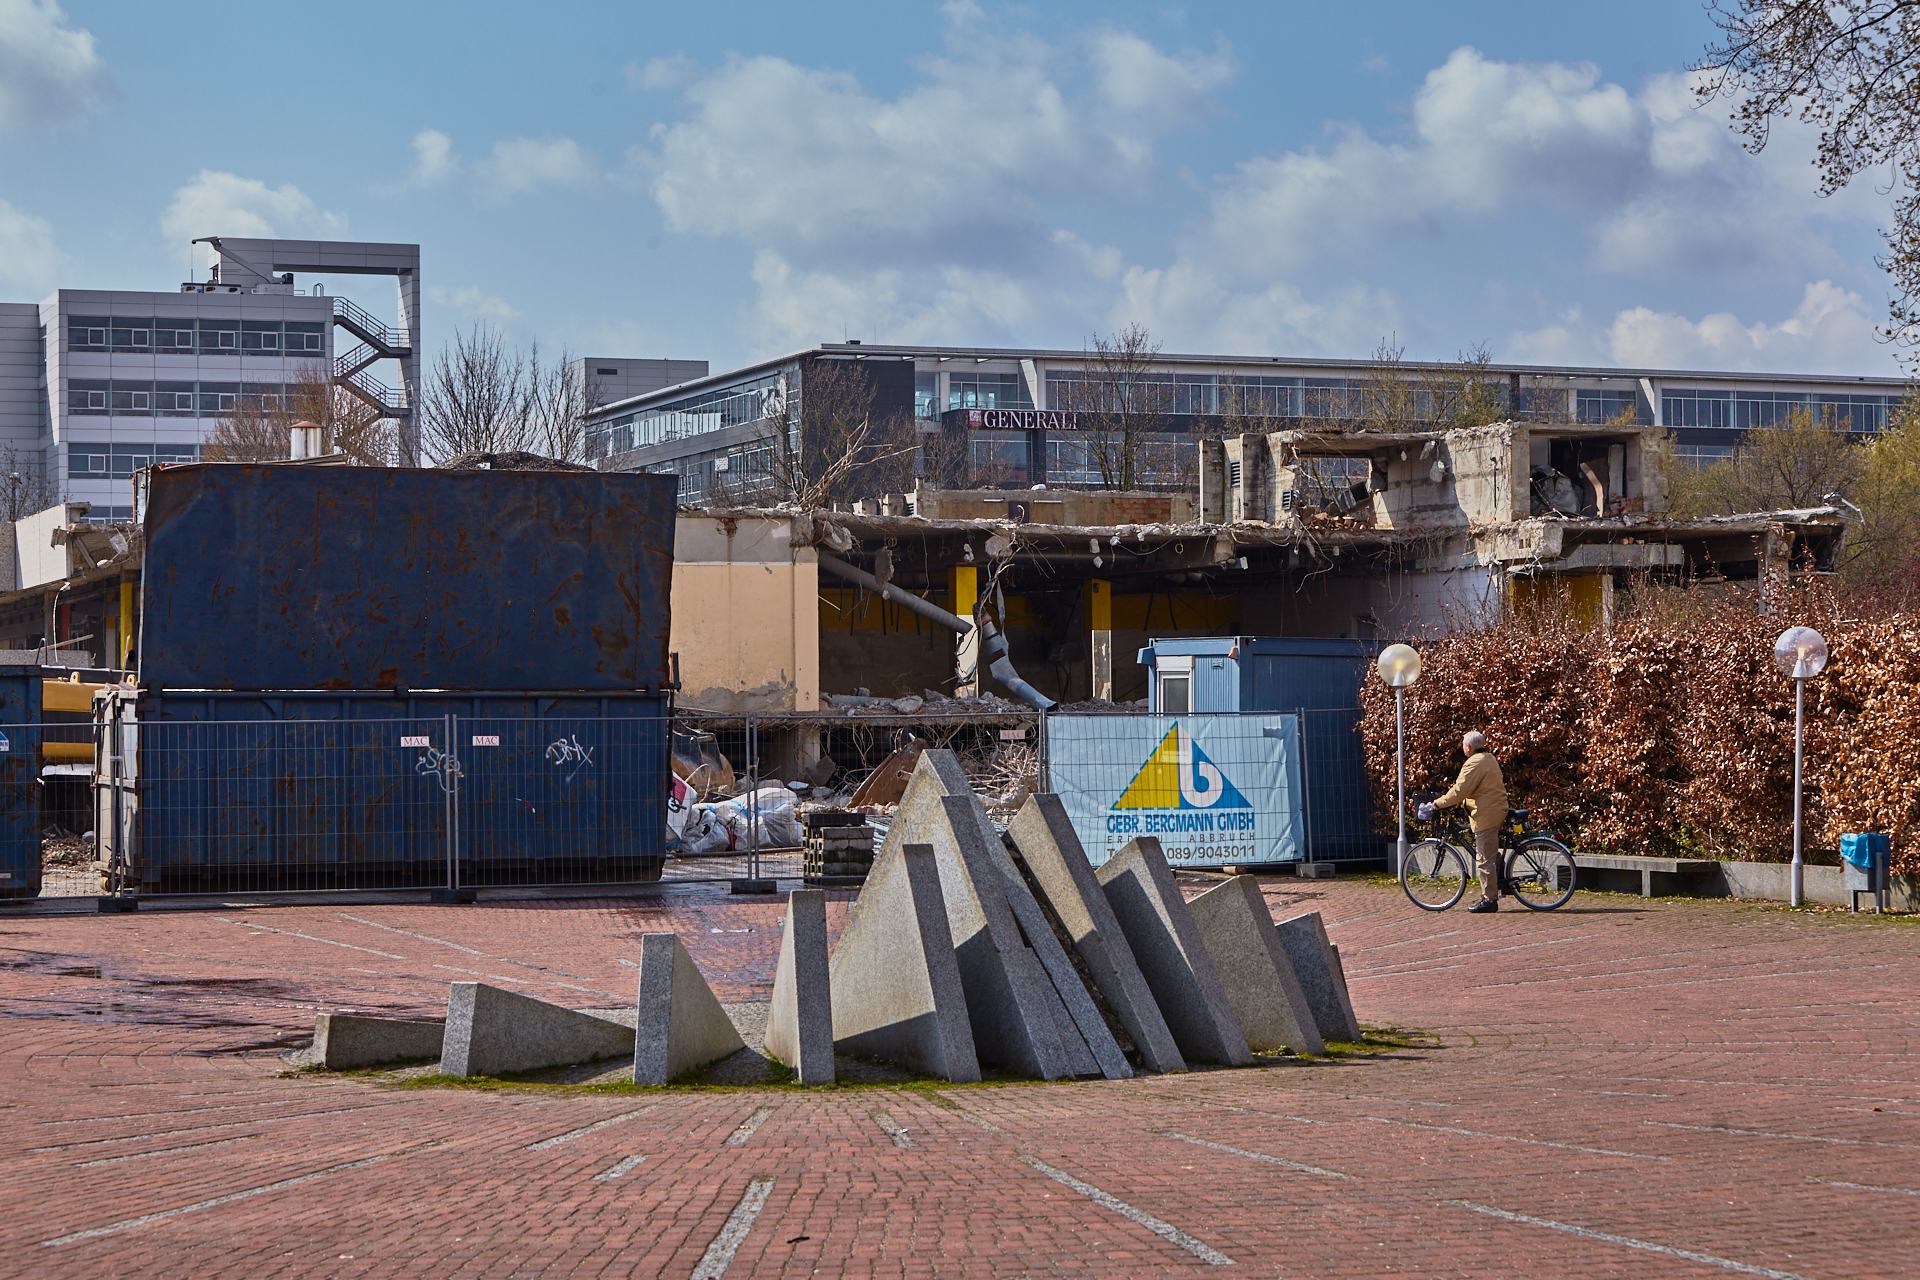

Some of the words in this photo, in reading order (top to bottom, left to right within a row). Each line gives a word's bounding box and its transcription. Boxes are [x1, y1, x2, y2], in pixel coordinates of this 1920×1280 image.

[984, 410, 1078, 430] GENERALI
[403, 737, 428, 746] MAC
[475, 736, 498, 745] MAC
[1107, 814, 1143, 833] GEBR.
[1146, 813, 1213, 832] BERGMANN
[1217, 811, 1255, 831] GMBH
[1189, 832, 1255, 843] ABBRUCH
[1166, 845, 1255, 860] 089/9043011
